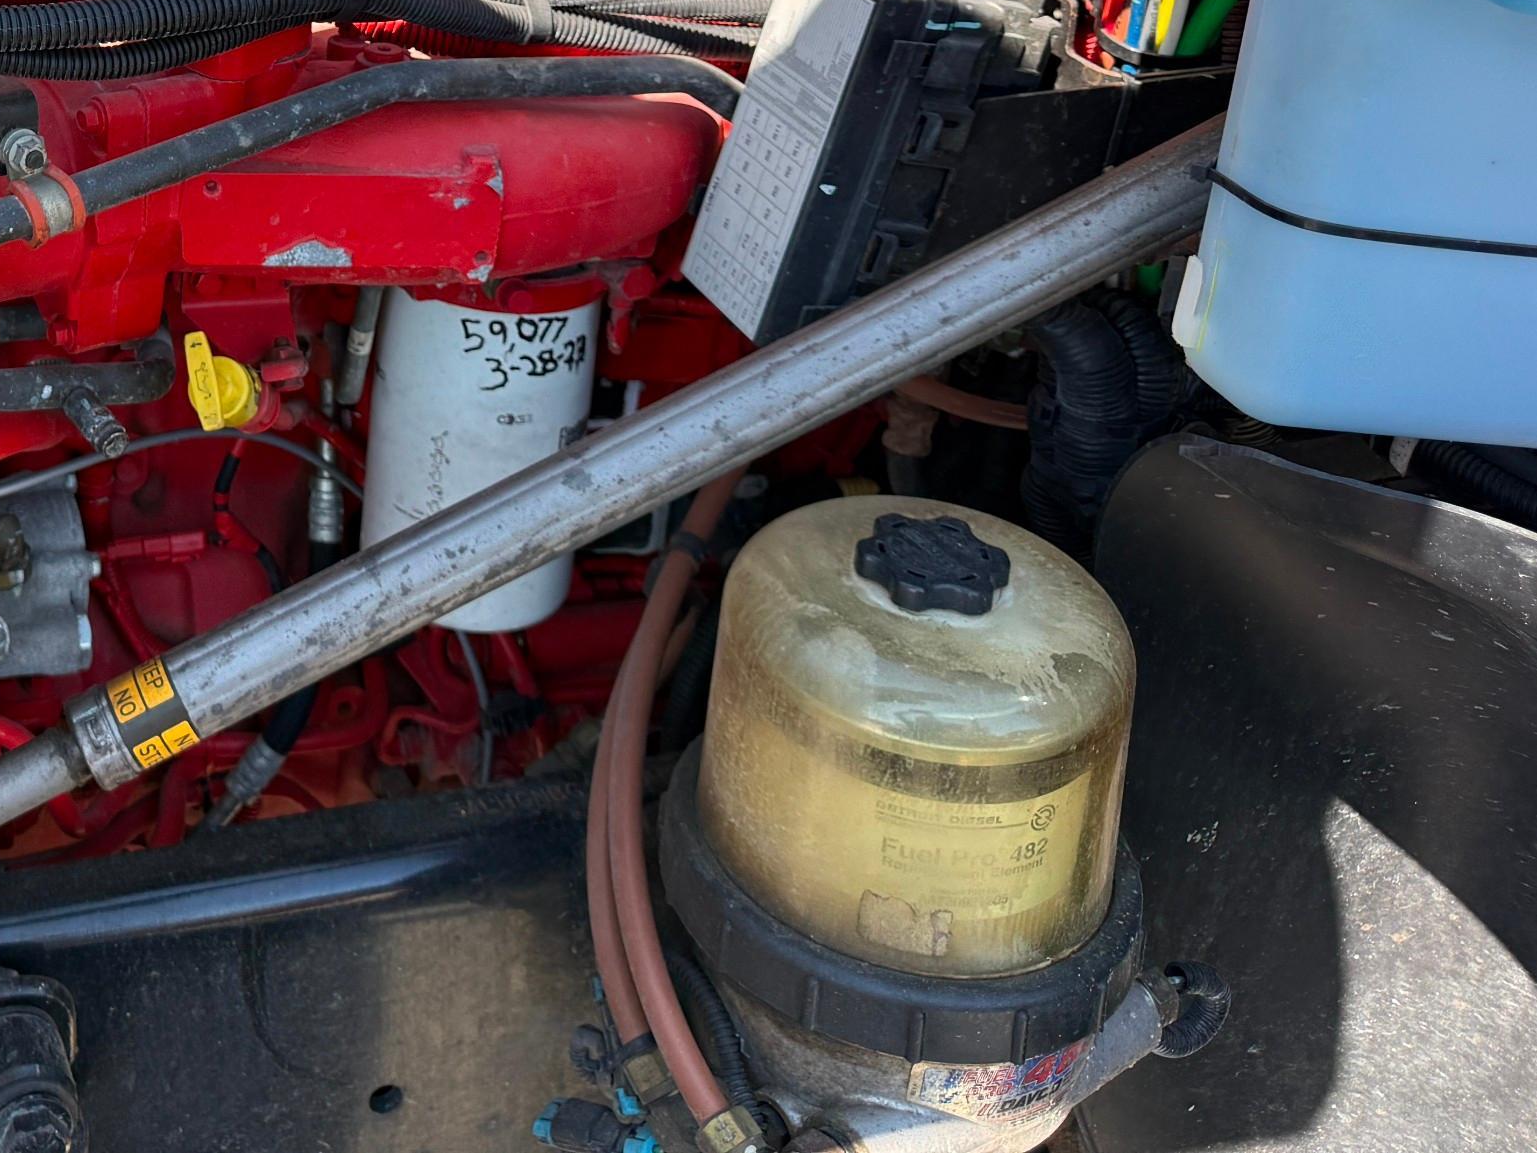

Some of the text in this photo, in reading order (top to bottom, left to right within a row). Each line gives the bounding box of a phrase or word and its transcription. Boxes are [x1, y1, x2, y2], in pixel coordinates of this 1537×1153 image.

[461, 316, 569, 352] 59,077
[143, 660, 164, 689] TEP
[113, 688, 136, 717] NO
[139, 743, 164, 766] ST
[881, 836, 1048, 867] Fuel Pro 482
[991, 856, 1043, 878] Element
